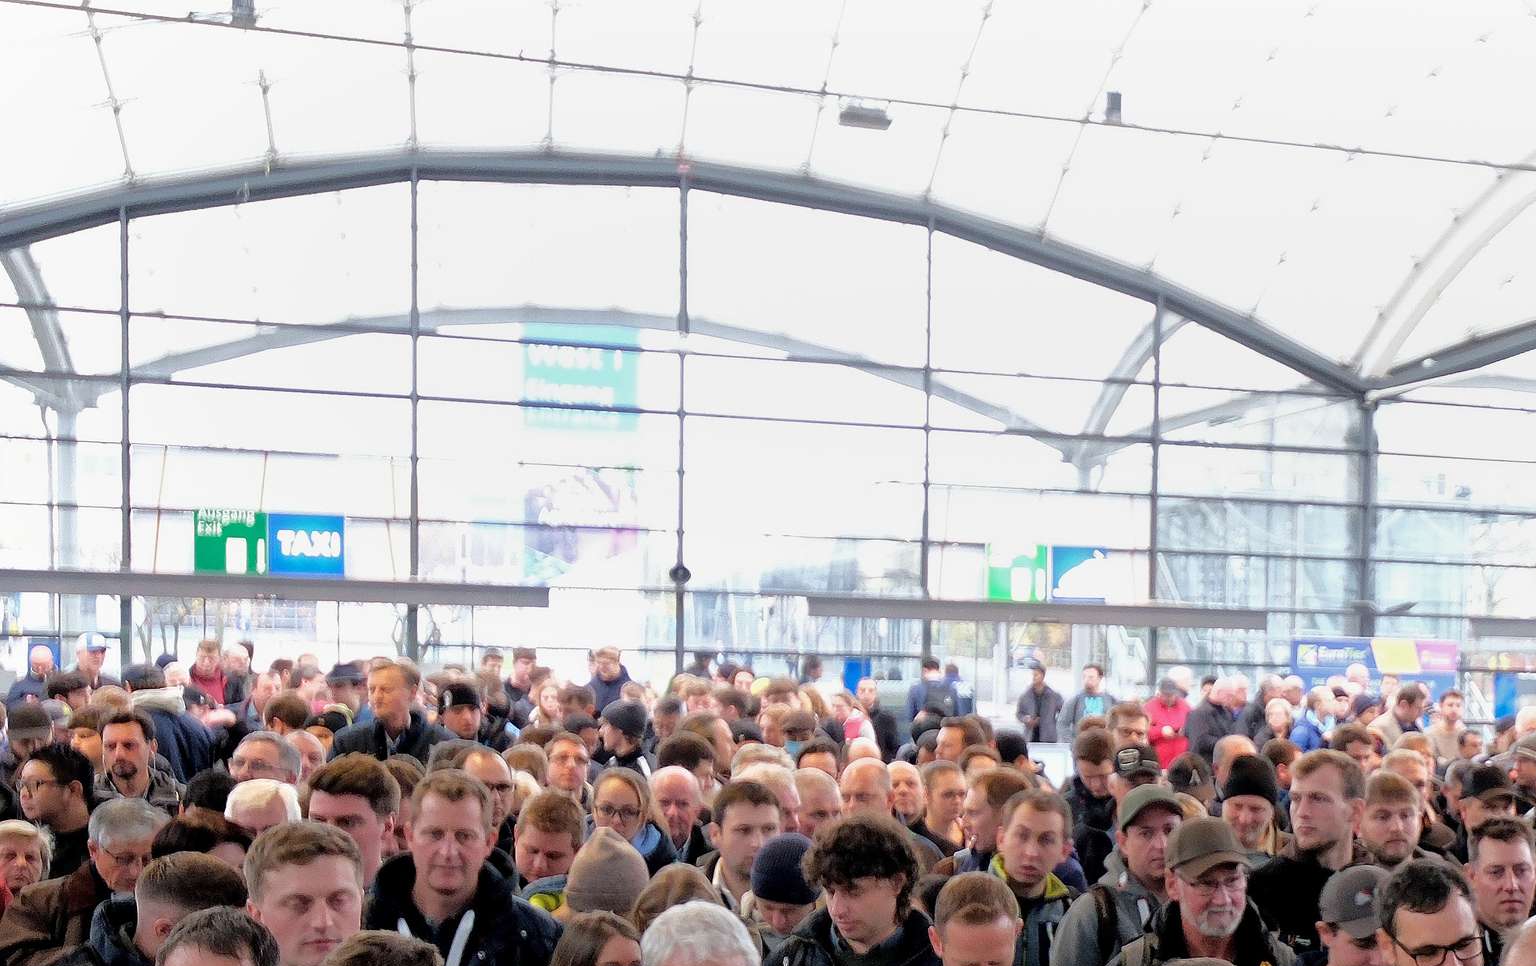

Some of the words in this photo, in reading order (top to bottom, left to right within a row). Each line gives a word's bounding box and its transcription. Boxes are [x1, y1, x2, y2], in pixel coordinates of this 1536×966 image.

[198, 507, 255, 527] Ausgang
[197, 519, 223, 537] Exit
[277, 528, 341, 558] TAXI
